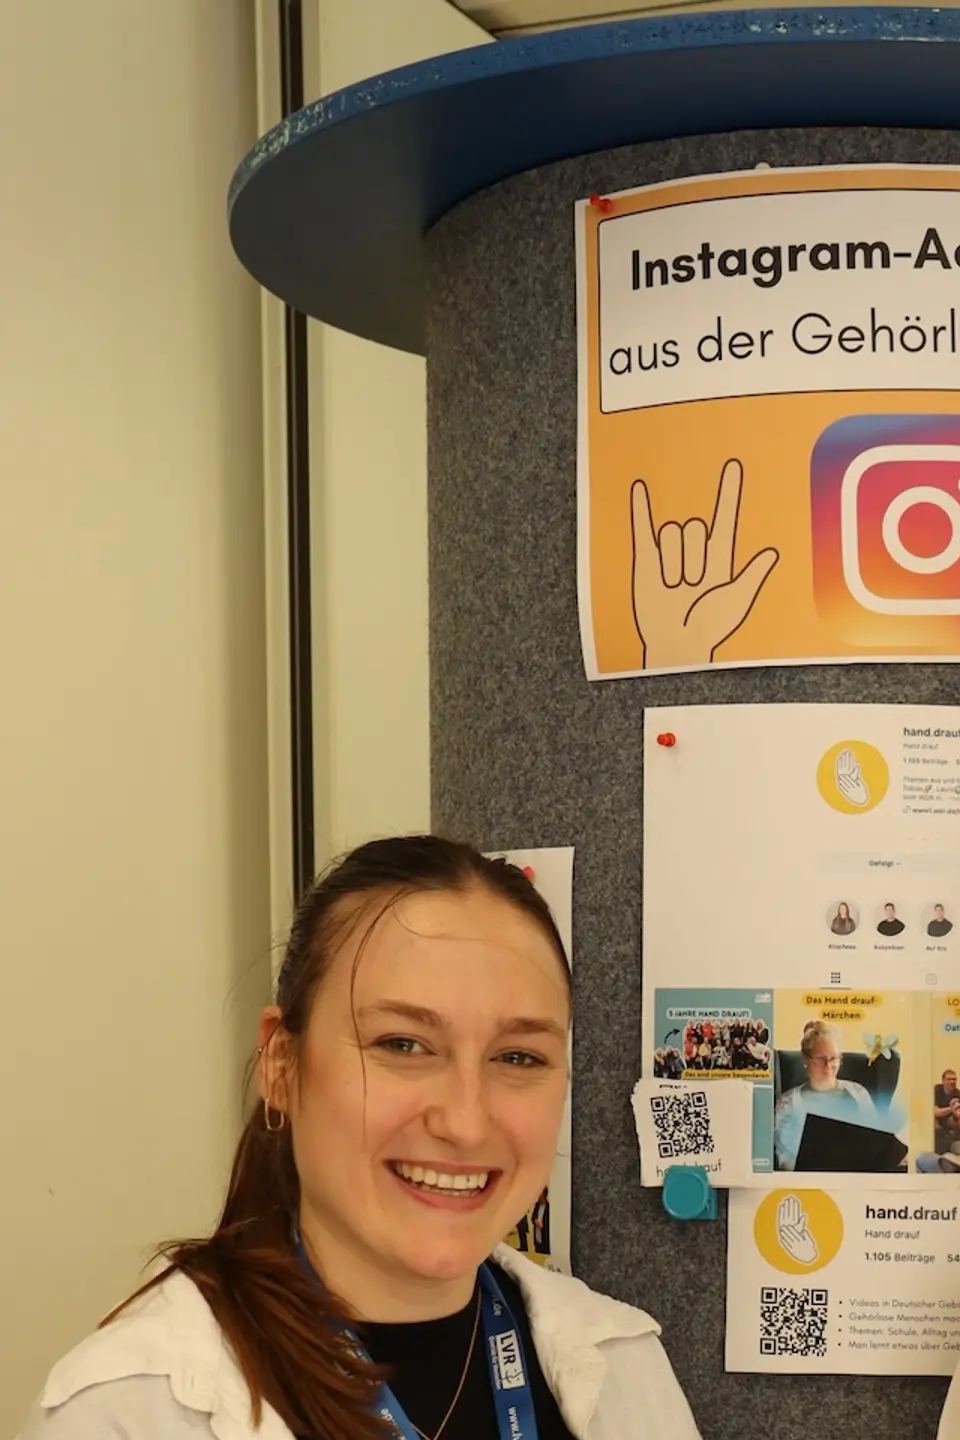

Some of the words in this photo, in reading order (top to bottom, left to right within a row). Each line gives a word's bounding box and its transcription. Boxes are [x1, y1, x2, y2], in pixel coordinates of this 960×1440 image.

[609, 339, 680, 375] aus
[697, 316, 774, 362] der
[806, 996, 822, 1004] Das
[825, 996, 848, 1004] Hand
[823, 1011, 861, 1019] Märchen
[865, 1205, 957, 1220] hand.drauf
[865, 1230, 891, 1239] Hand
[894, 1230, 920, 1239] drauf
[865, 1252, 891, 1261] 1.105
[894, 1252, 935, 1263] Beiträge
[849, 1299, 879, 1307] Videos
[892, 1299, 936, 1308] Deutscher
[922, 1328, 947, 1338] Alltag
[500, 1334, 517, 1366] LVR
[849, 1341, 867, 1349] Man
[892, 1342, 918, 1350] etwas
